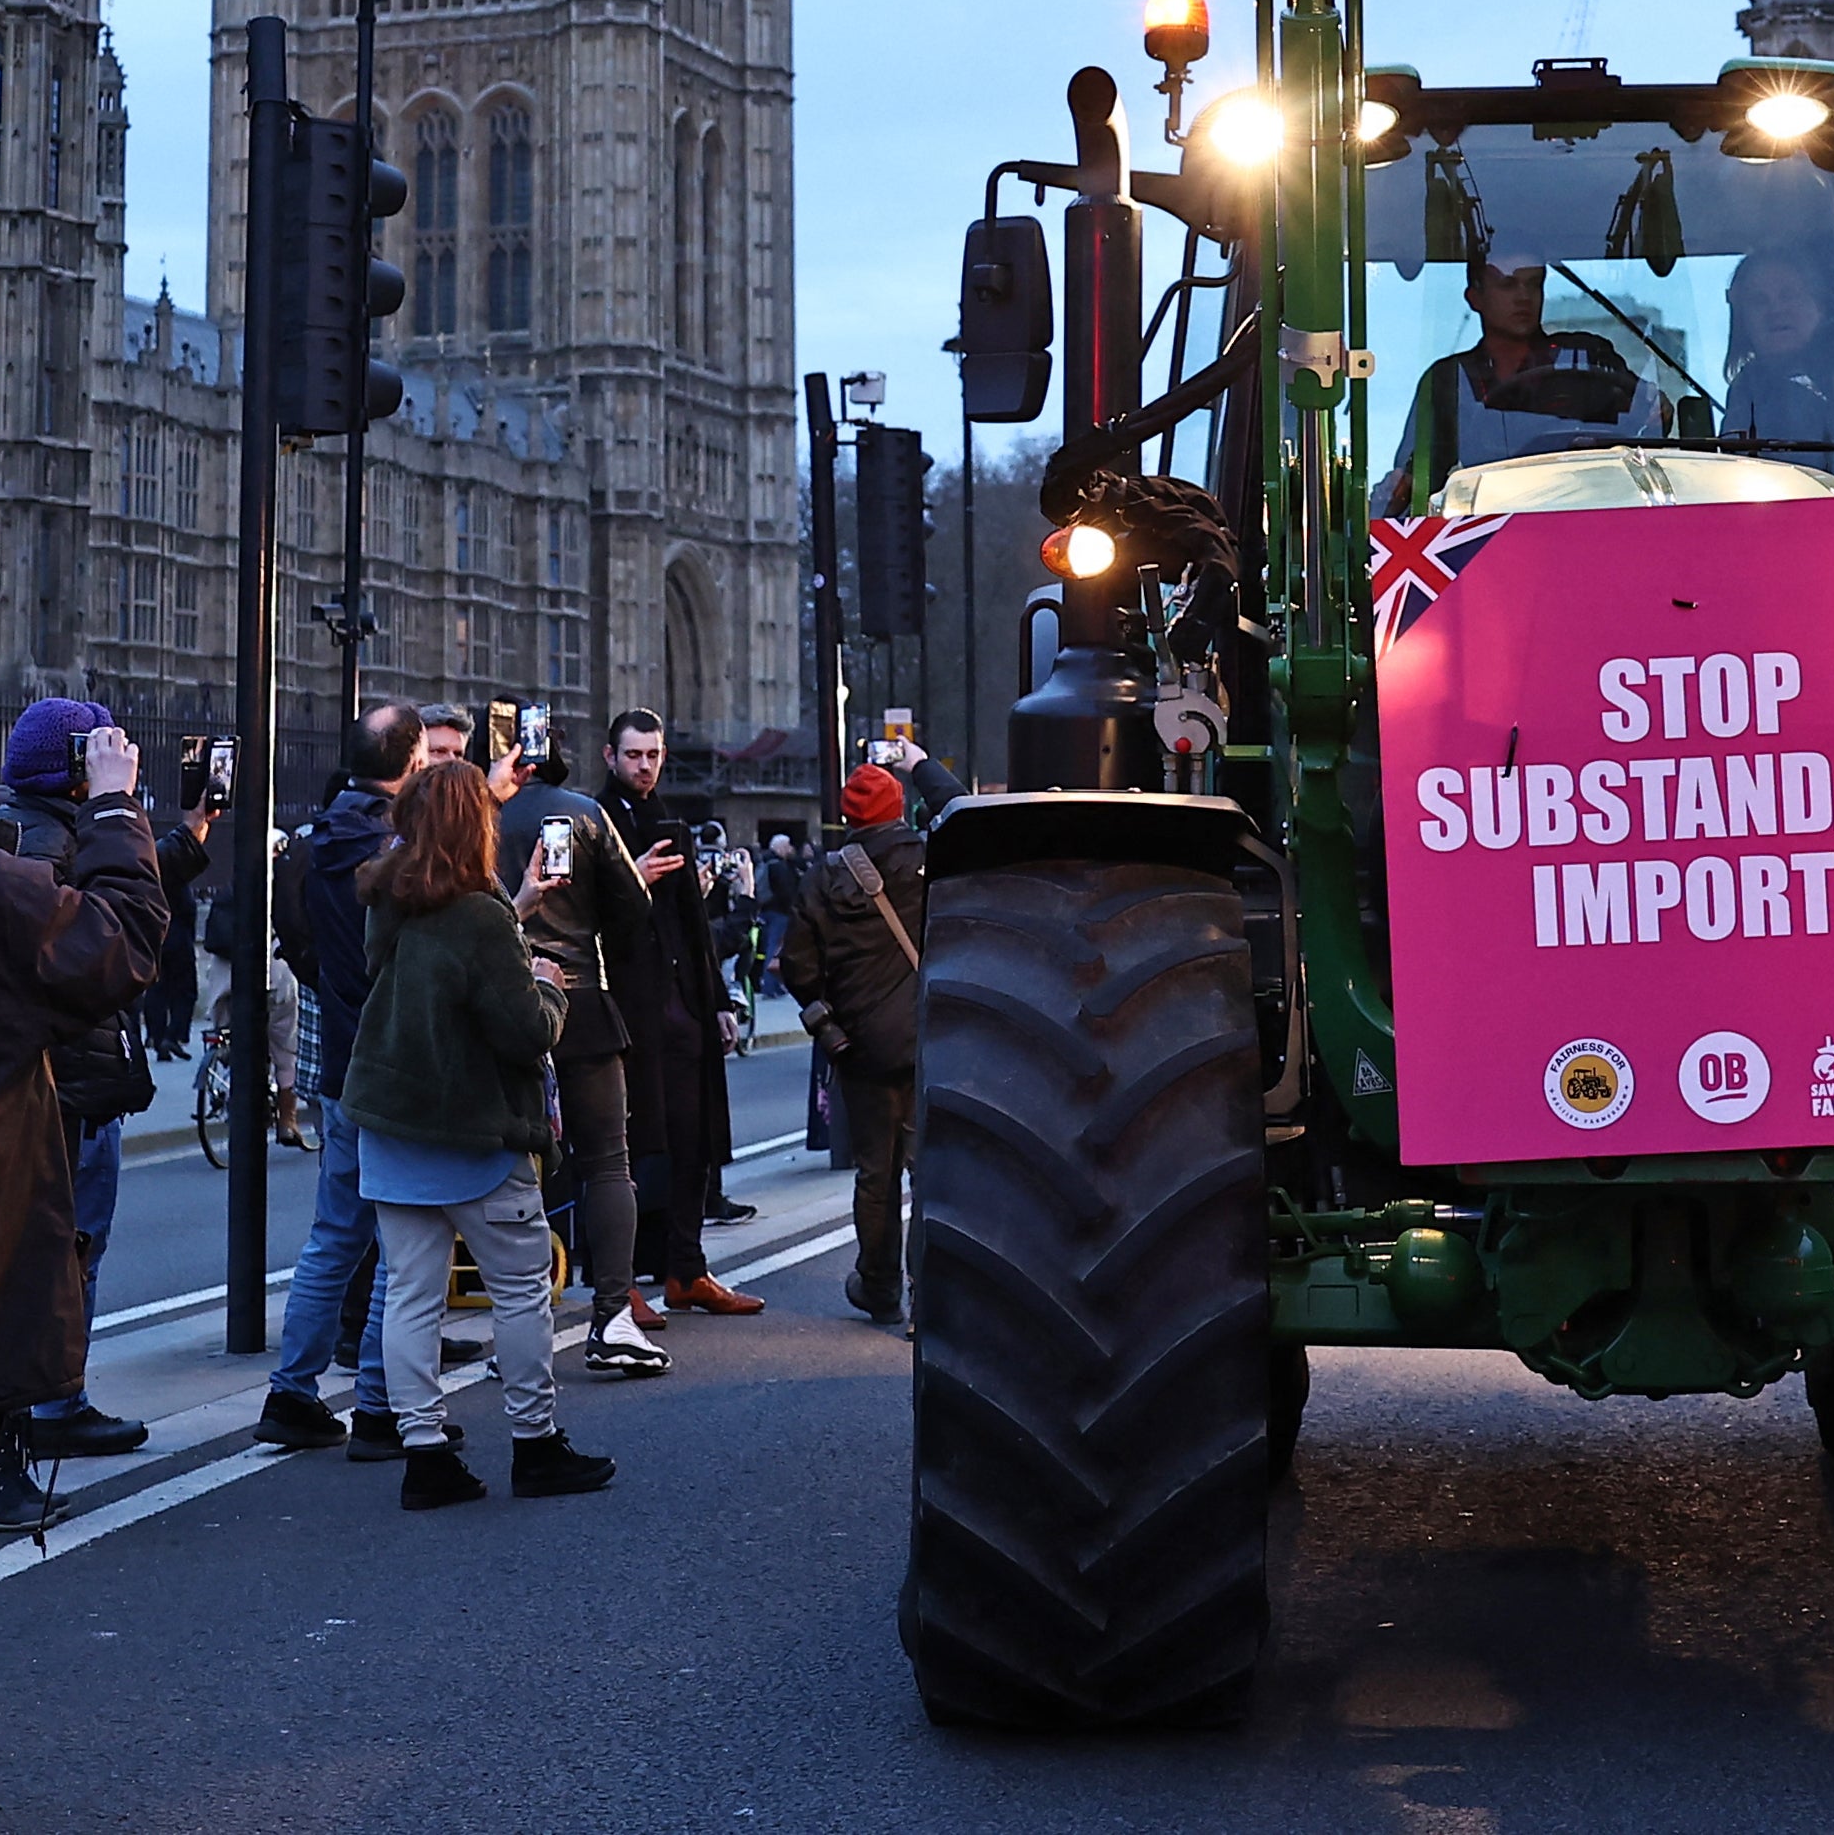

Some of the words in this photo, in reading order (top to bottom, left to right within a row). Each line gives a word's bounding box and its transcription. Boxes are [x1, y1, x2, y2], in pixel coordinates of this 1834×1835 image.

[1599, 652, 1801, 743] STOP
[1550, 1042, 1604, 1073] FAIRNESS
[1604, 1048, 1627, 1070] FOR
[1699, 1053, 1749, 1091] OB
